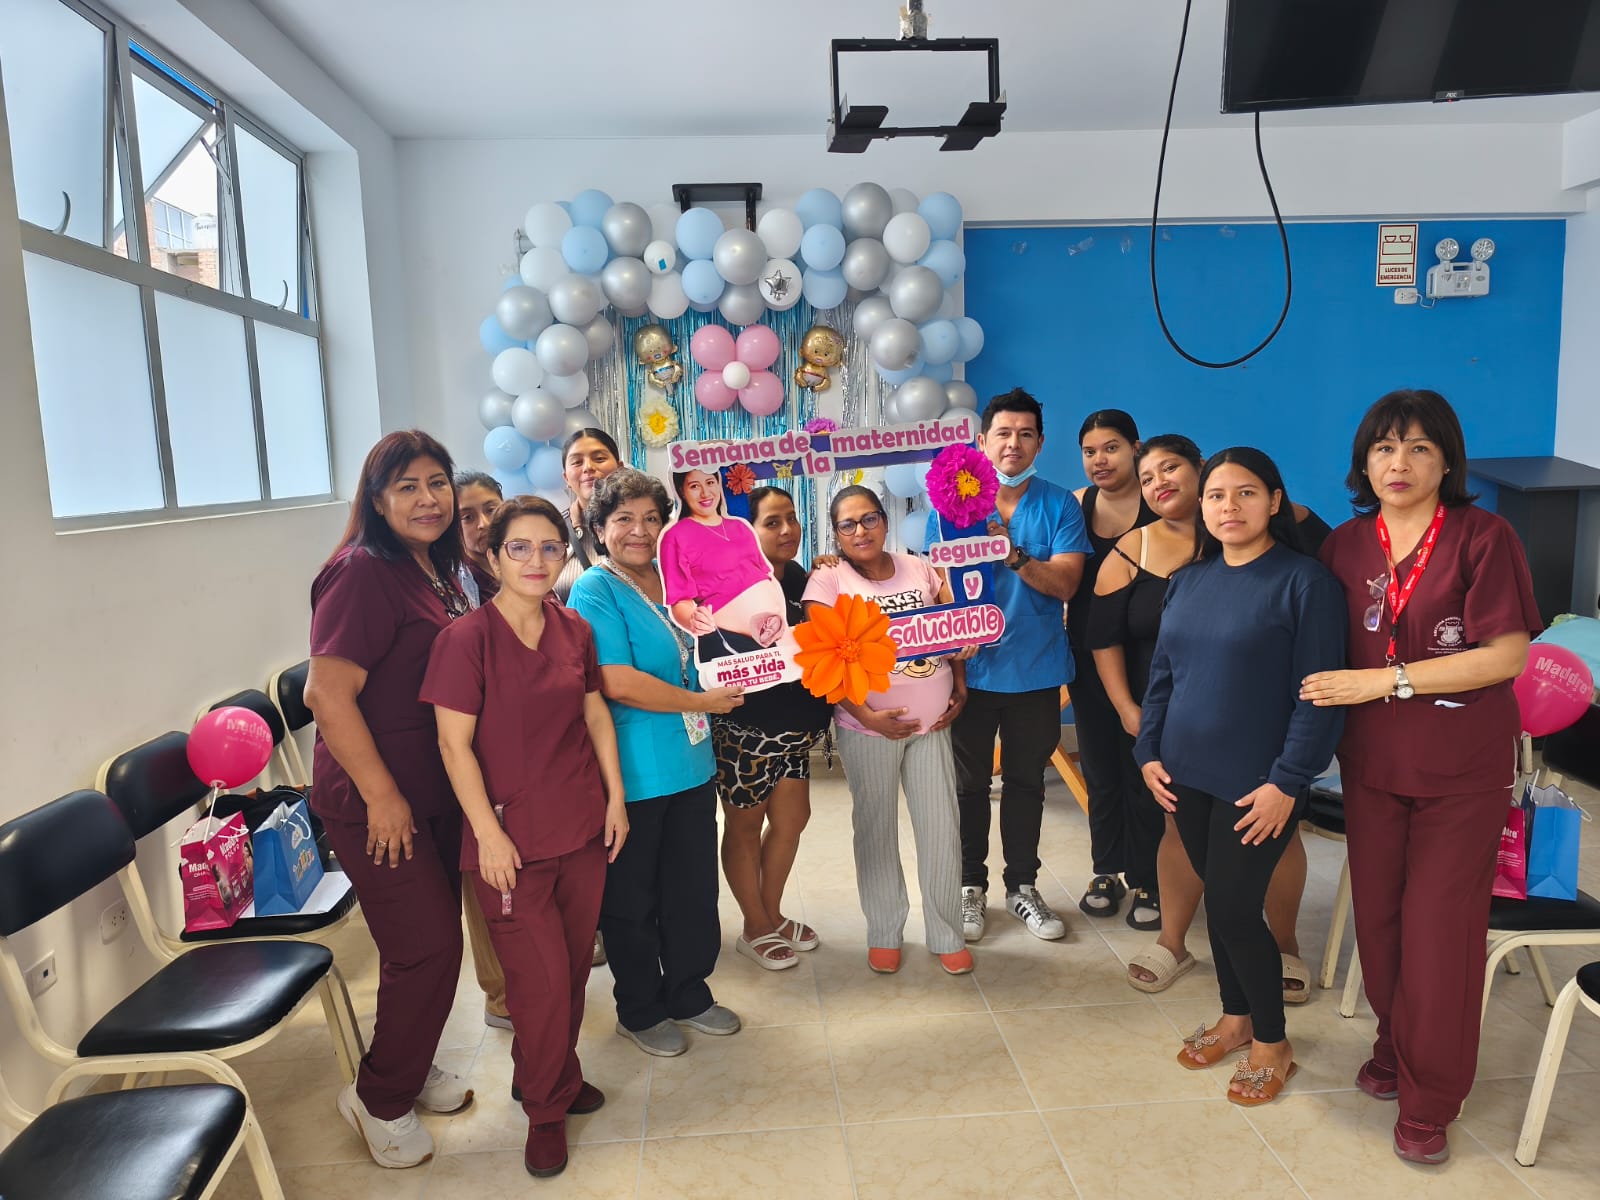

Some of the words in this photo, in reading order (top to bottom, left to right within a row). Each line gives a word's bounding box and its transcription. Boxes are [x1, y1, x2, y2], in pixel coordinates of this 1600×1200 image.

[671, 441, 776, 469] Semana
[779, 432, 810, 455] de
[832, 418, 970, 453] maternidad
[806, 452, 831, 475] la
[931, 539, 1007, 564] segura
[965, 577, 979, 597] y
[889, 607, 999, 646] saludable
[733, 655, 755, 665] SALUD
[755, 652, 773, 660] PARA
[717, 664, 750, 683] más
[753, 659, 786, 675] vida
[1535, 656, 1588, 694] Maddre
